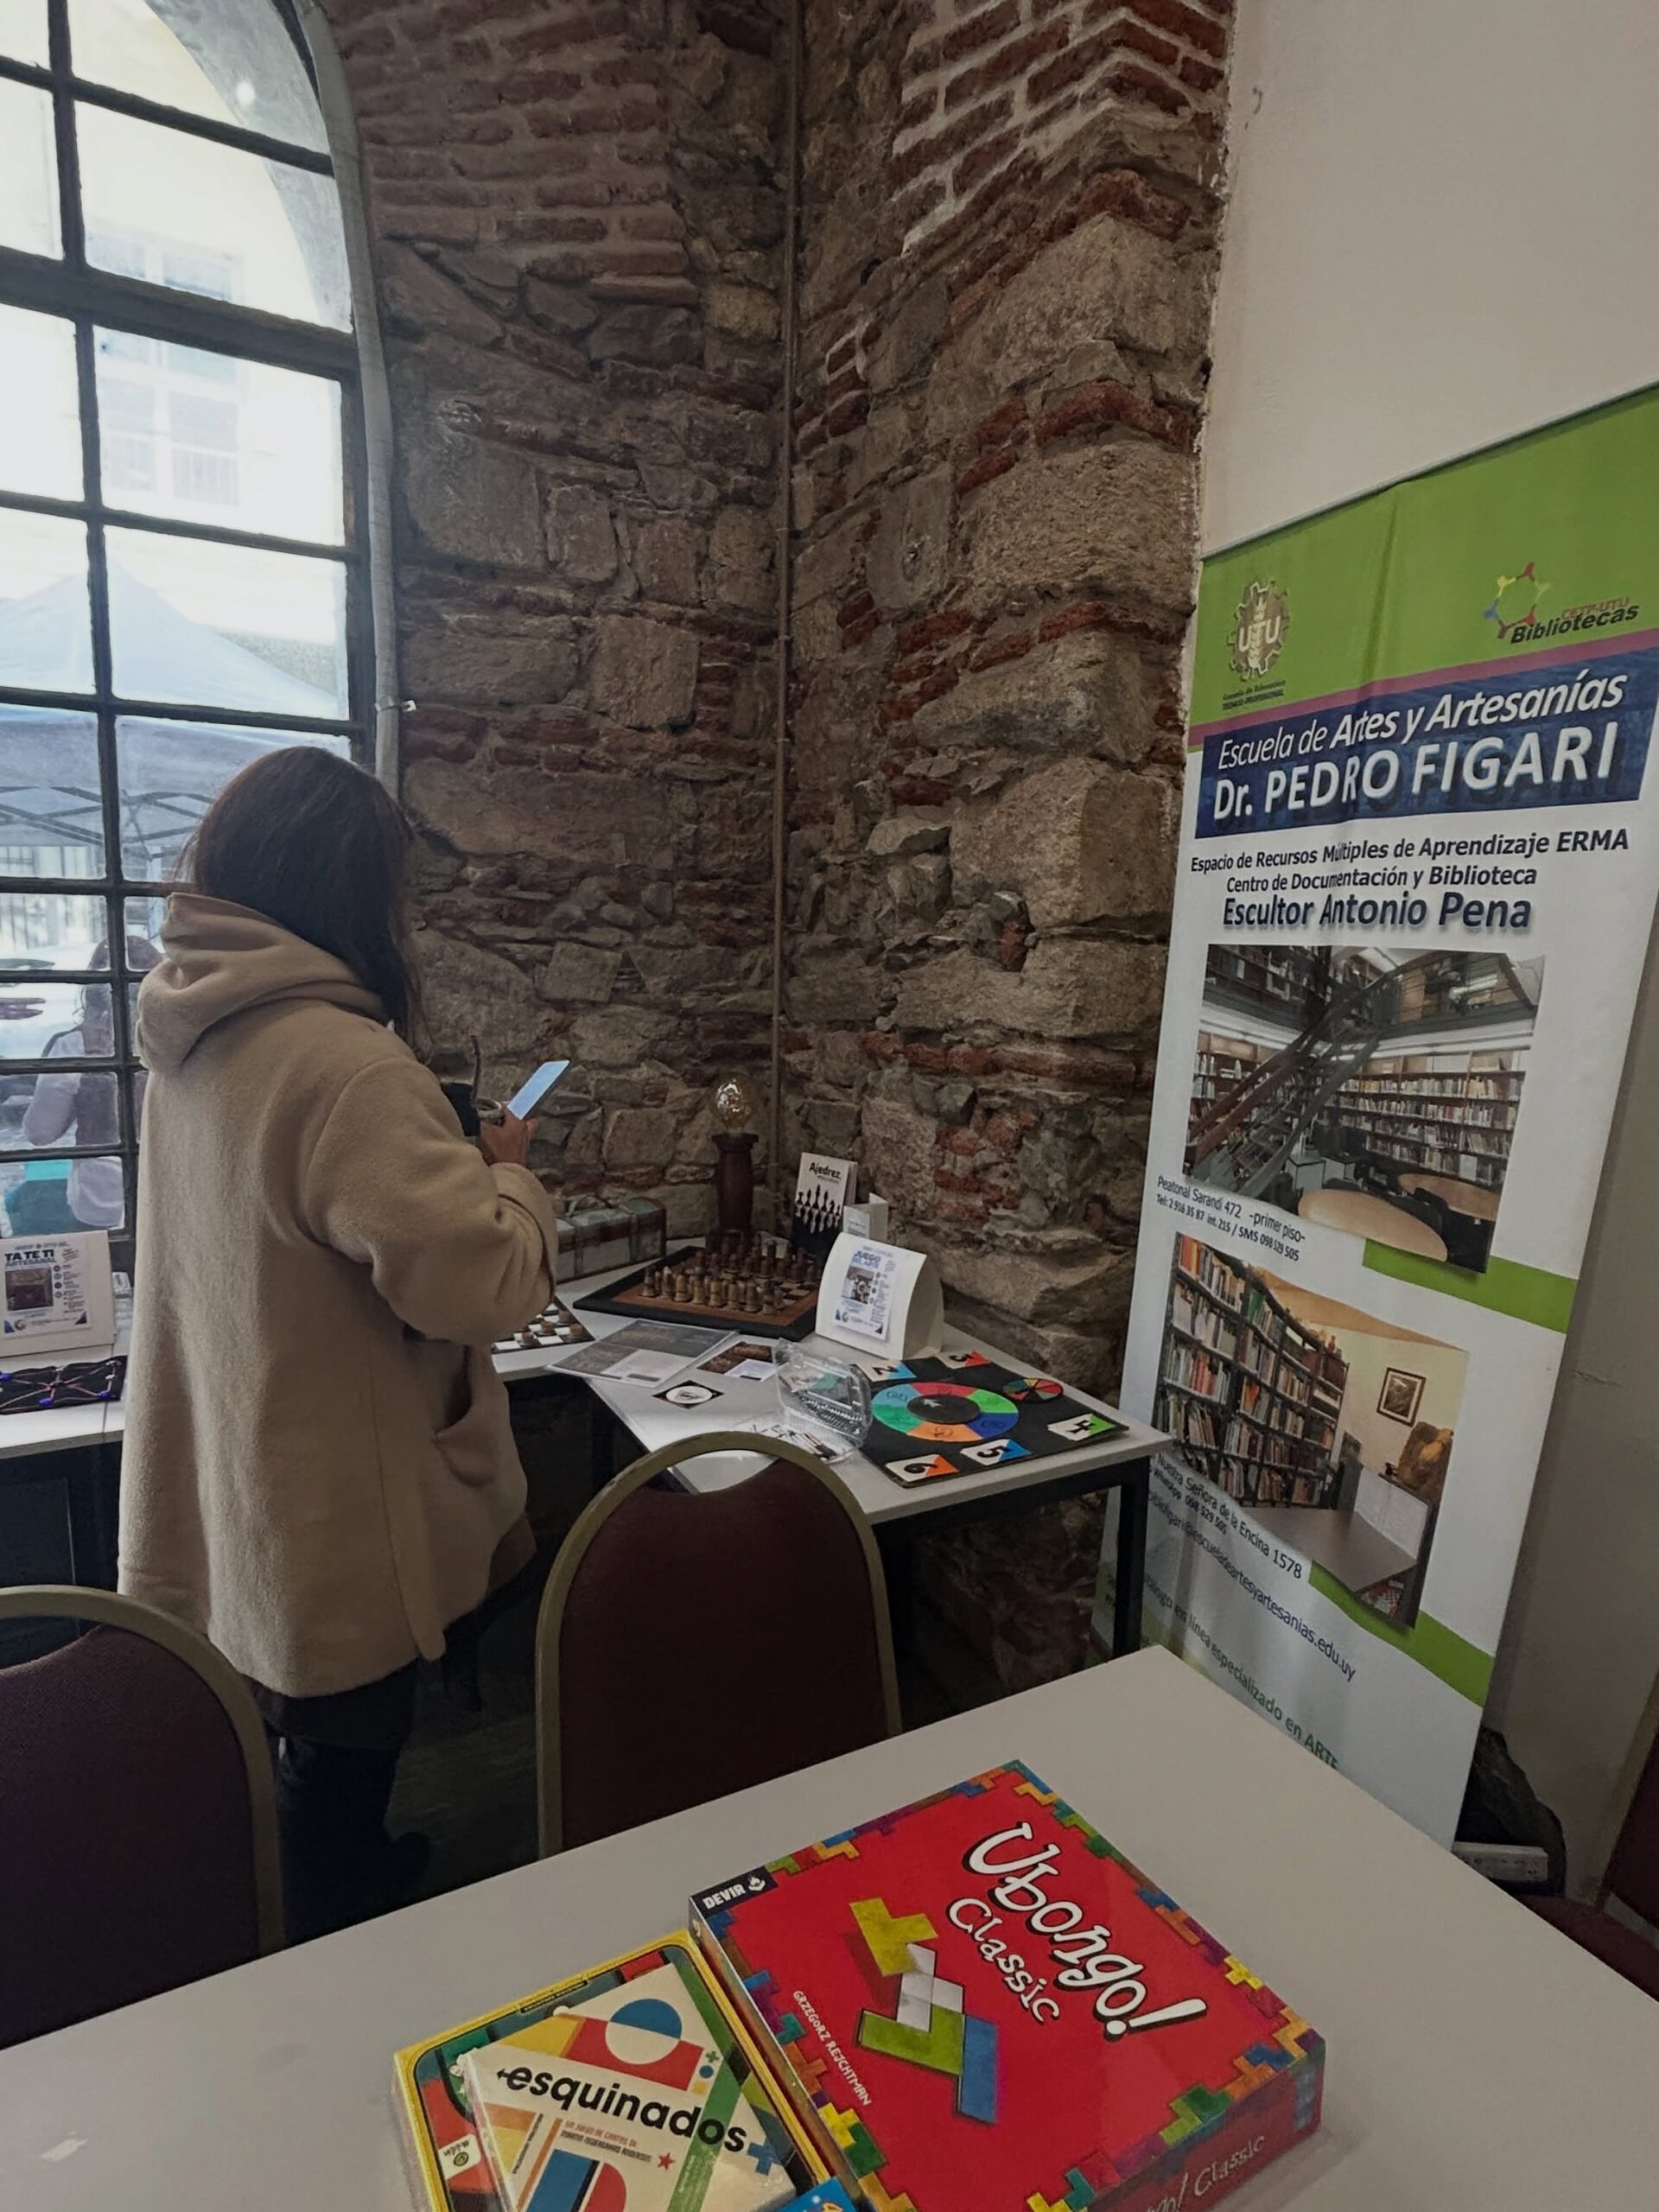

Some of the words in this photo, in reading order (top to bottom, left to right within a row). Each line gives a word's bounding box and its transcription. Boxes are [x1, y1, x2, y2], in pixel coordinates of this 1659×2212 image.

[1238, 614, 1281, 652] UTU
[1510, 605, 1639, 644] Bibliotecas
[1218, 725, 1295, 771] Escuela
[1298, 720, 1326, 755] de
[1330, 709, 1402, 750] Artes
[1402, 705, 1425, 744] y
[1426, 669, 1627, 733] Artesanías
[1214, 779, 1253, 819] Dr.
[1265, 750, 1399, 814] PEDRO
[1412, 721, 1618, 794] FIGARI
[1191, 854, 1234, 875] Espacio
[1236, 852, 1253, 869] de
[1256, 849, 1318, 868] Recursos
[1394, 838, 1414, 858] de
[1419, 832, 1550, 861] Aprendizaje
[1556, 829, 1630, 853] ERMA
[1227, 877, 1268, 893] Centro
[1272, 874, 1288, 891] de
[1291, 866, 1407, 890] Documentación
[1412, 869, 1424, 889] y
[1429, 865, 1537, 886] Biblioteca
[1223, 893, 1315, 926] Escultor
[1319, 890, 1427, 926] Antonio
[1439, 892, 1532, 928] Pena
[1158, 1175, 1191, 1198] Peatonal
[1224, 1200, 1243, 1218] 472
[4, 1253, 22, 1262] TA
[23, 1250, 40, 1259] TE
[41, 1249, 54, 1257] TI
[1239, 1226, 1258, 1243] SMS
[1284, 1245, 1300, 1262] 505
[977, 1445, 1013, 1459] 5
[1185, 1477, 1217, 1510] Señora
[1219, 1503, 1230, 1522] de
[1239, 1521, 1270, 1556] Encina
[1273, 1548, 1303, 1580] 1578
[1211, 1643, 1283, 1721] especializado
[1286, 1715, 1302, 1740] en
[702, 1884, 747, 1910] DEVIR
[965, 1821, 1208, 2037] Ubongo!
[948, 1897, 1061, 2024] Classic
[793, 1990, 831, 2042] GRZEGORZ
[825, 2040, 872, 2106] REJCHTMAN
[498, 2063, 748, 2153] esquinados
[1194, 2135, 1266, 2196] Classic
